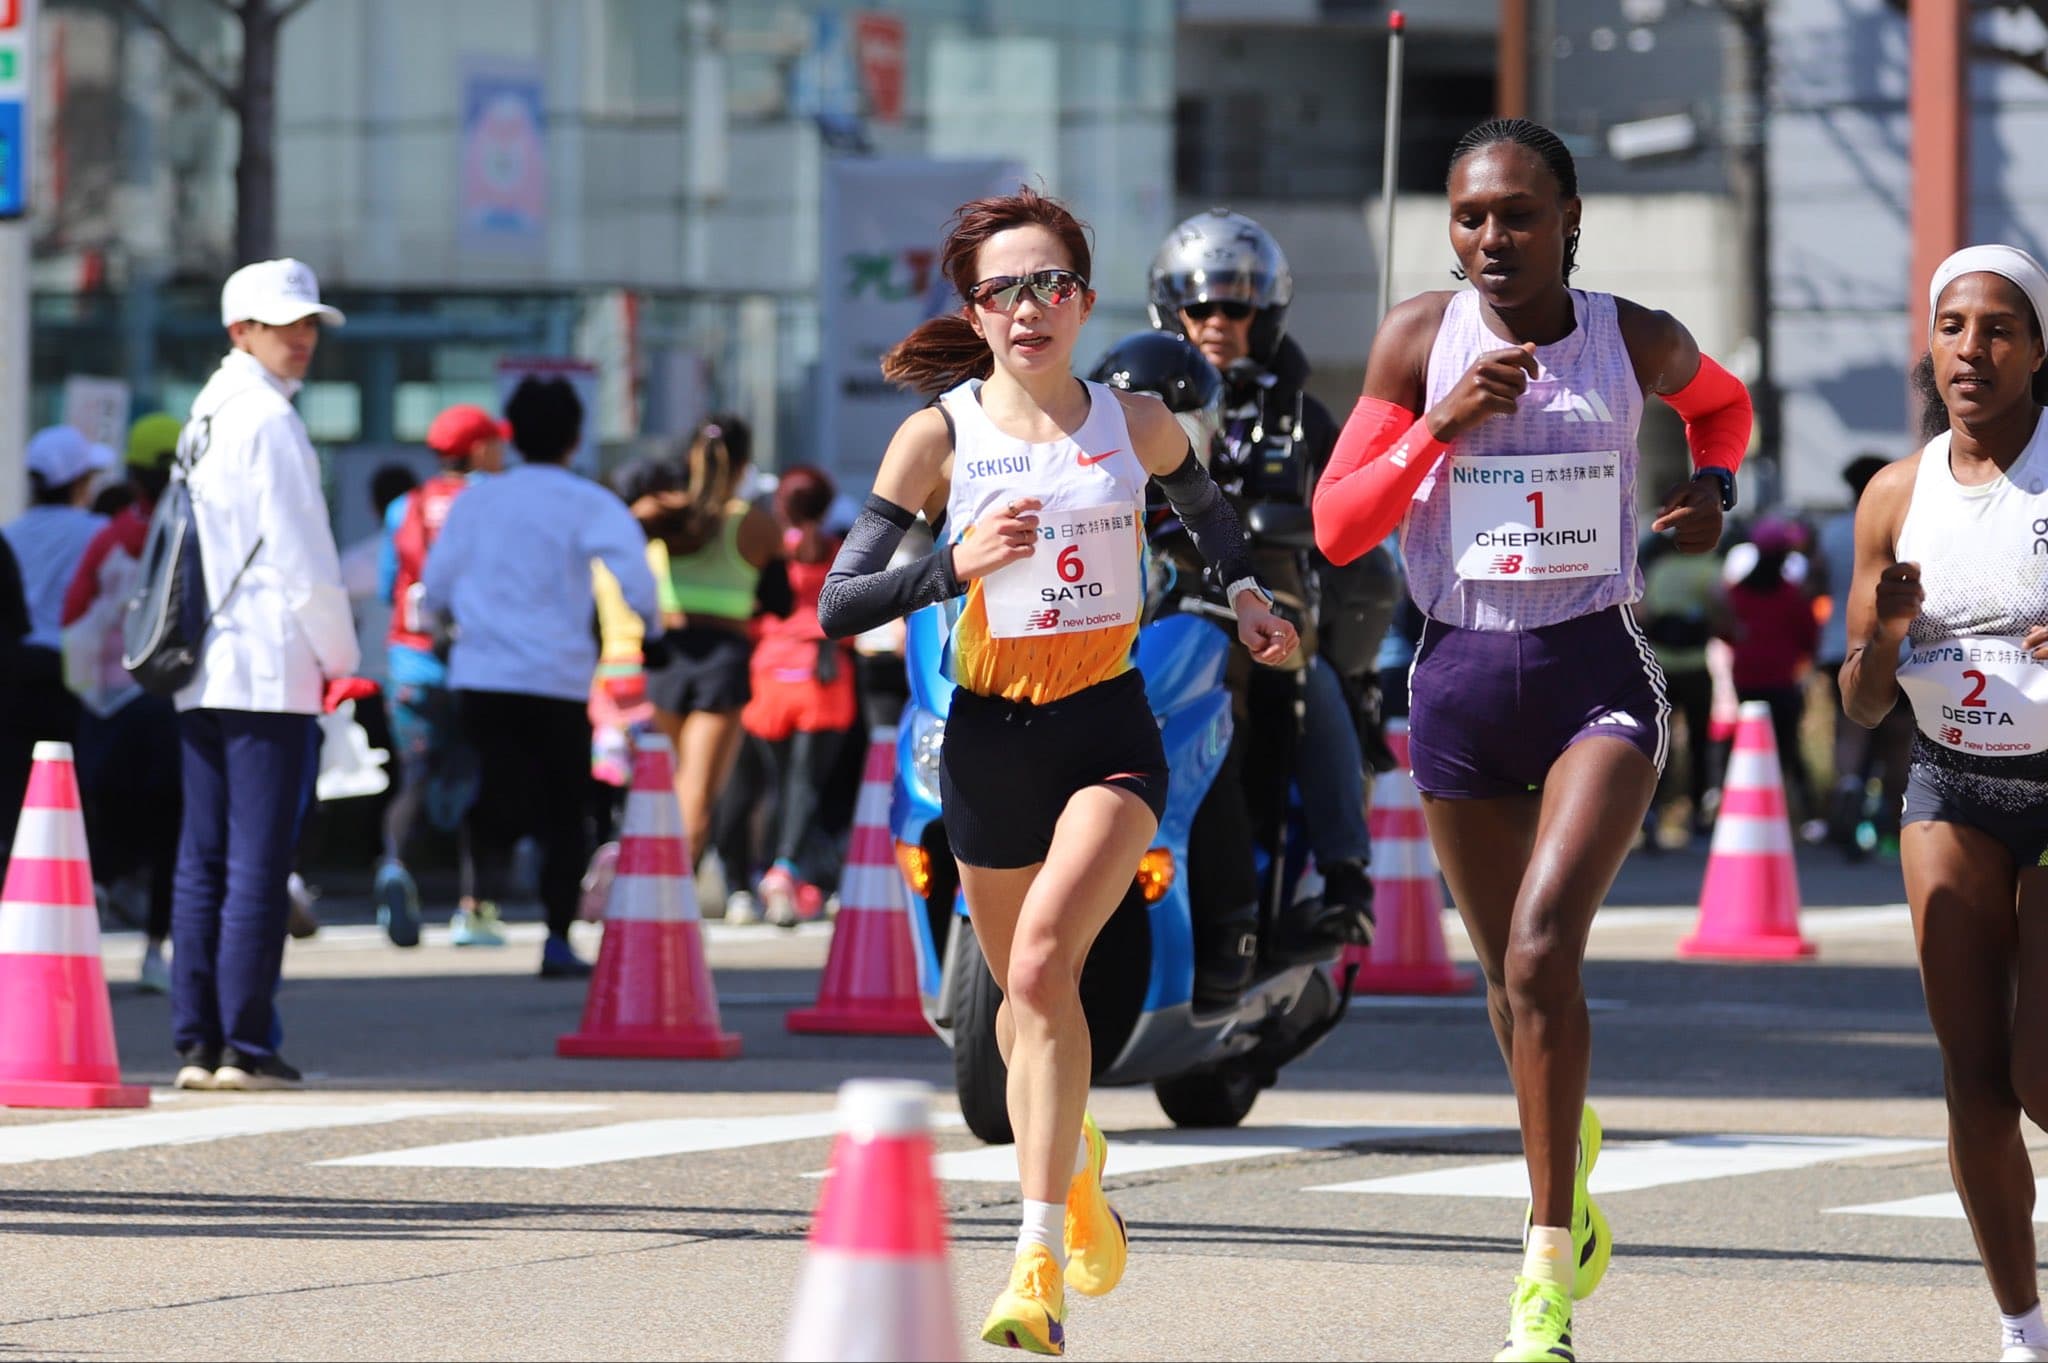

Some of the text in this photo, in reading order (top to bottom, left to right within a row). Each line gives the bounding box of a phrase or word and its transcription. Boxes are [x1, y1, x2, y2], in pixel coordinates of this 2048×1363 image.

[967, 456, 1031, 479] SEKISUI
[1453, 464, 1615, 484] Niterra 日本特殊陶業
[1526, 491, 1544, 528] 1
[1061, 515, 1133, 538] 日本特殊陶業
[1475, 529, 1597, 547] CHEPKIRUI
[1056, 544, 1084, 583] 6
[1525, 566, 1546, 574] new
[1548, 562, 1589, 573] balance
[1041, 582, 1103, 602] SATO
[1063, 618, 1084, 628] new
[1086, 612, 1121, 625] balance
[1910, 647, 1964, 665] Niterra
[1961, 669, 1987, 707] 2
[1942, 705, 2014, 726] DESTA
[1964, 741, 1983, 749] new
[1986, 739, 2031, 752] balance
